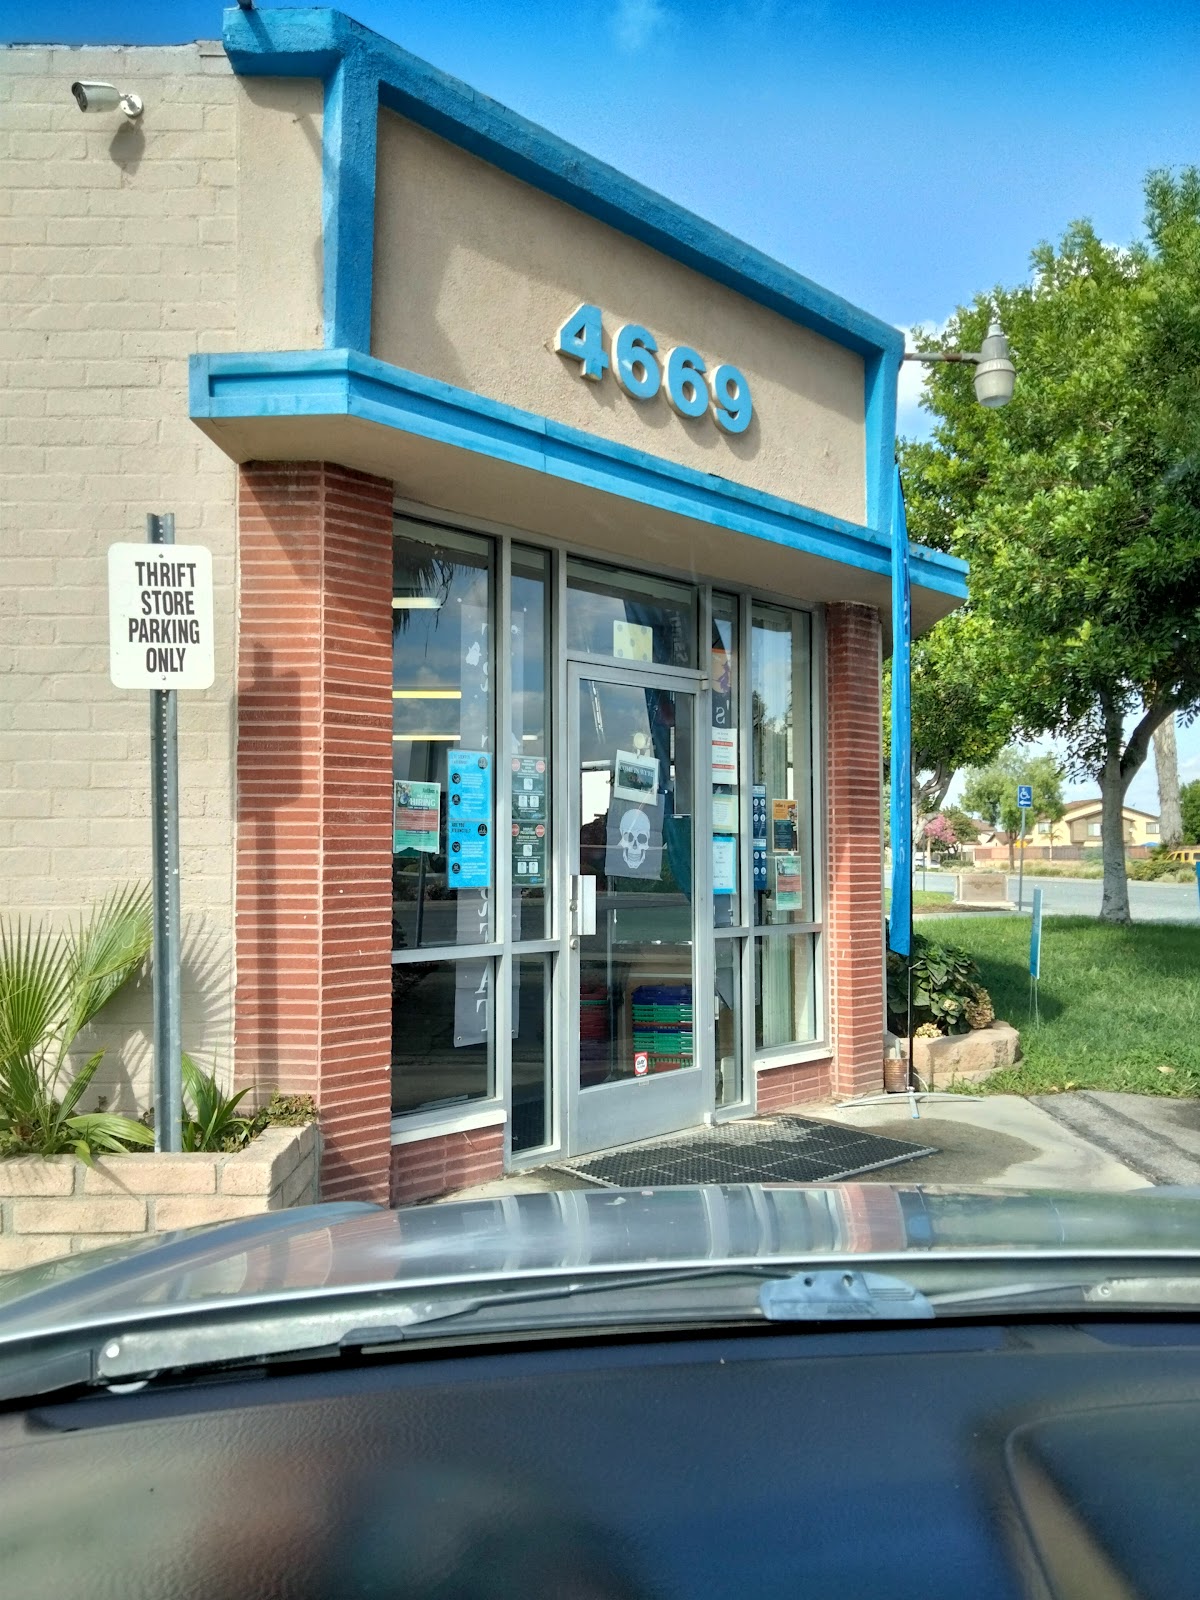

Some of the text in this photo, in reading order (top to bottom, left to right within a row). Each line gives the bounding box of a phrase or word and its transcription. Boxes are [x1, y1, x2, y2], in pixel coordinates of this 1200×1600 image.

[554, 302, 753, 434] 4669
[134, 561, 196, 588] THRIFT
[141, 590, 195, 616] STORE
[128, 617, 200, 644] PARKING
[145, 647, 186, 673] ONLY
[410, 797, 436, 807] HIRING
